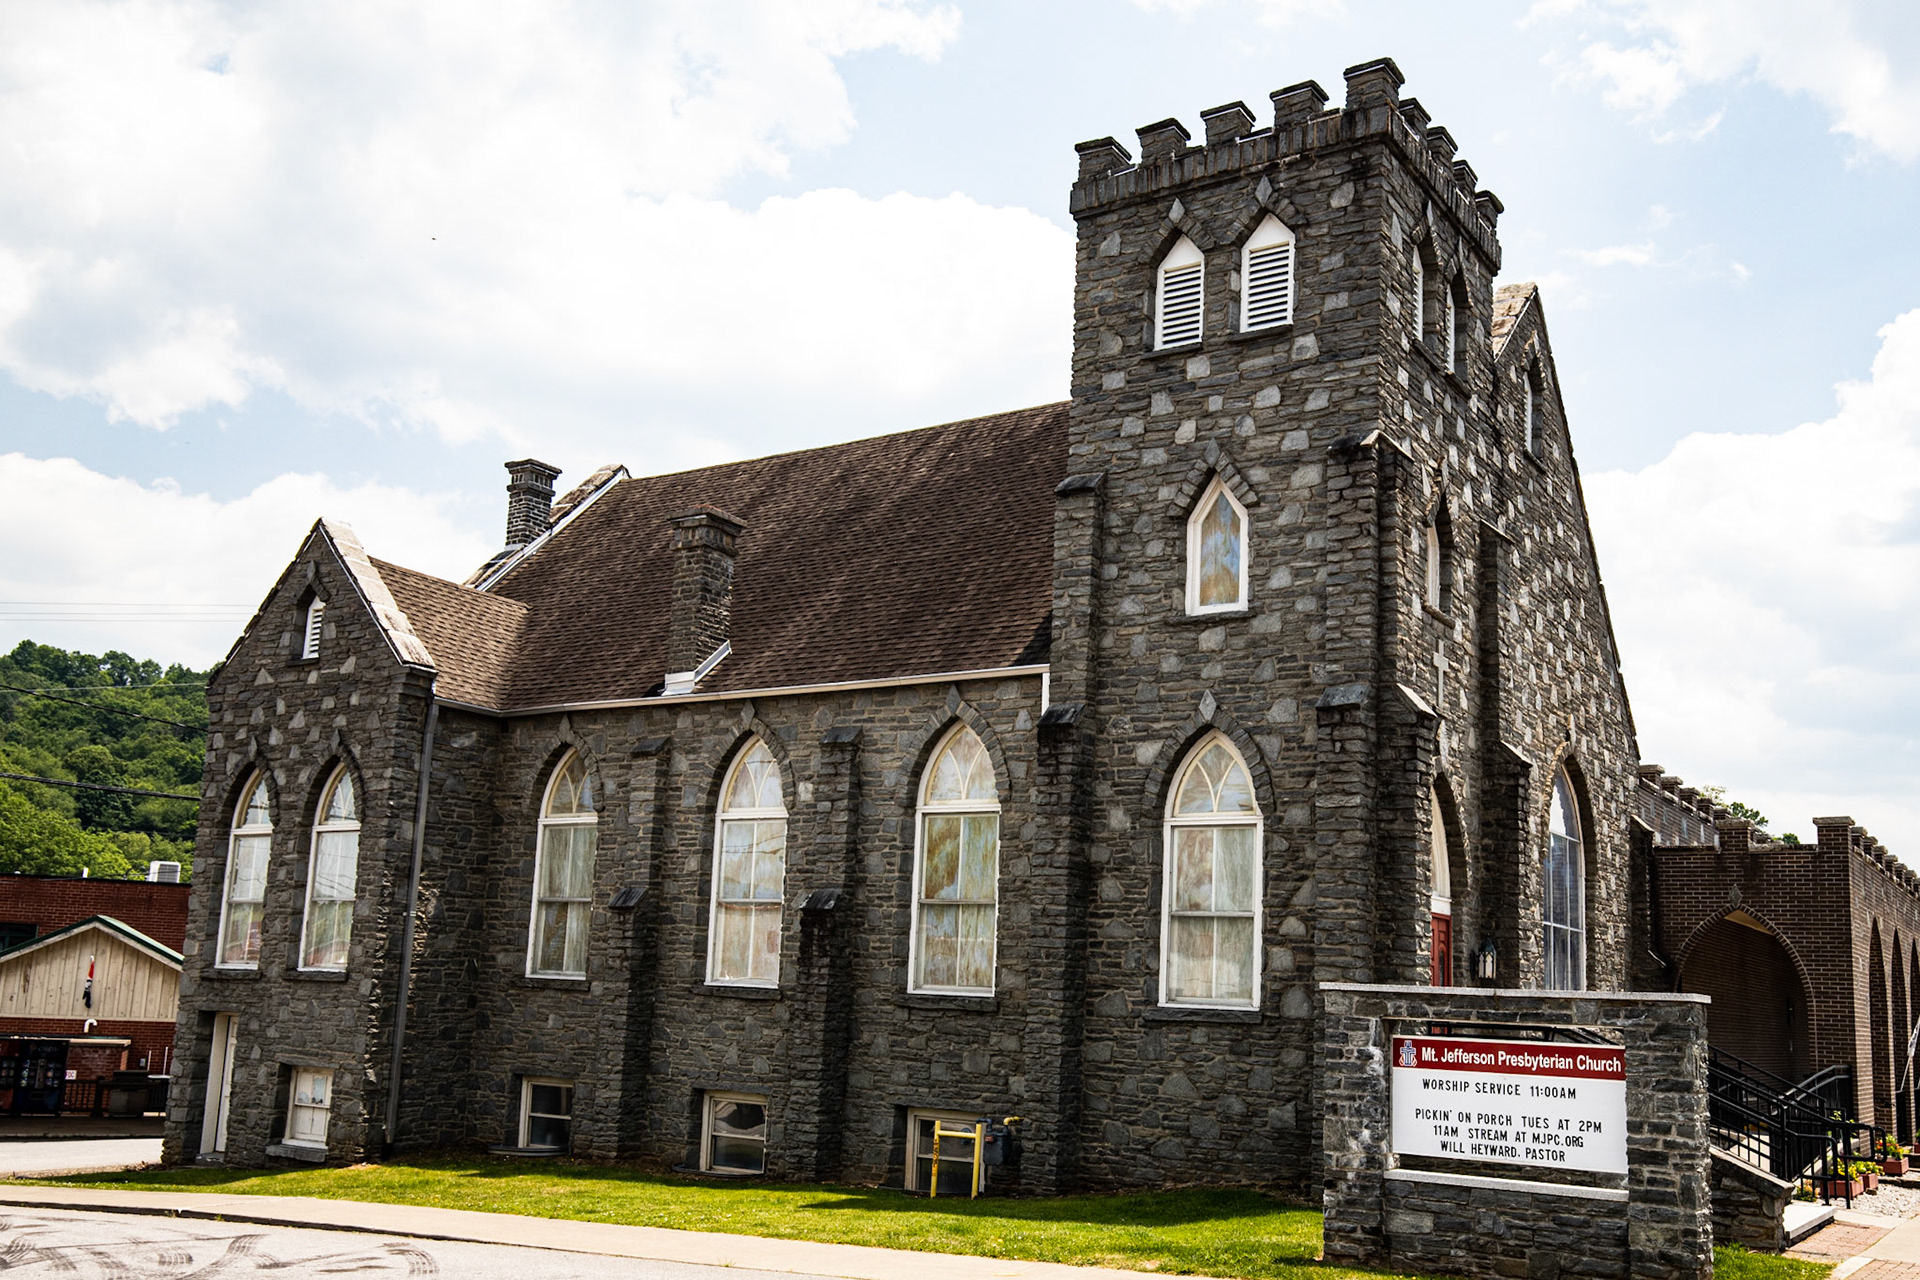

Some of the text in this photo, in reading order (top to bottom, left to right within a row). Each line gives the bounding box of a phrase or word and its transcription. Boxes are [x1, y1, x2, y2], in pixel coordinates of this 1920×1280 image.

[1421, 1046, 1622, 1073] Mt. Jefferson Presbyterian Church
[1422, 1079, 1576, 1099] WORSHIP SERVICE 11:00AM
[1415, 1108, 1602, 1133] PICKIN' ON PORCH TUES AT 2PM
[1433, 1125, 1584, 1147] 11AM STREAM AT MJPC.ORG
[1441, 1140, 1465, 1154] WILL
[1526, 1148, 1566, 1162] PASTOR
